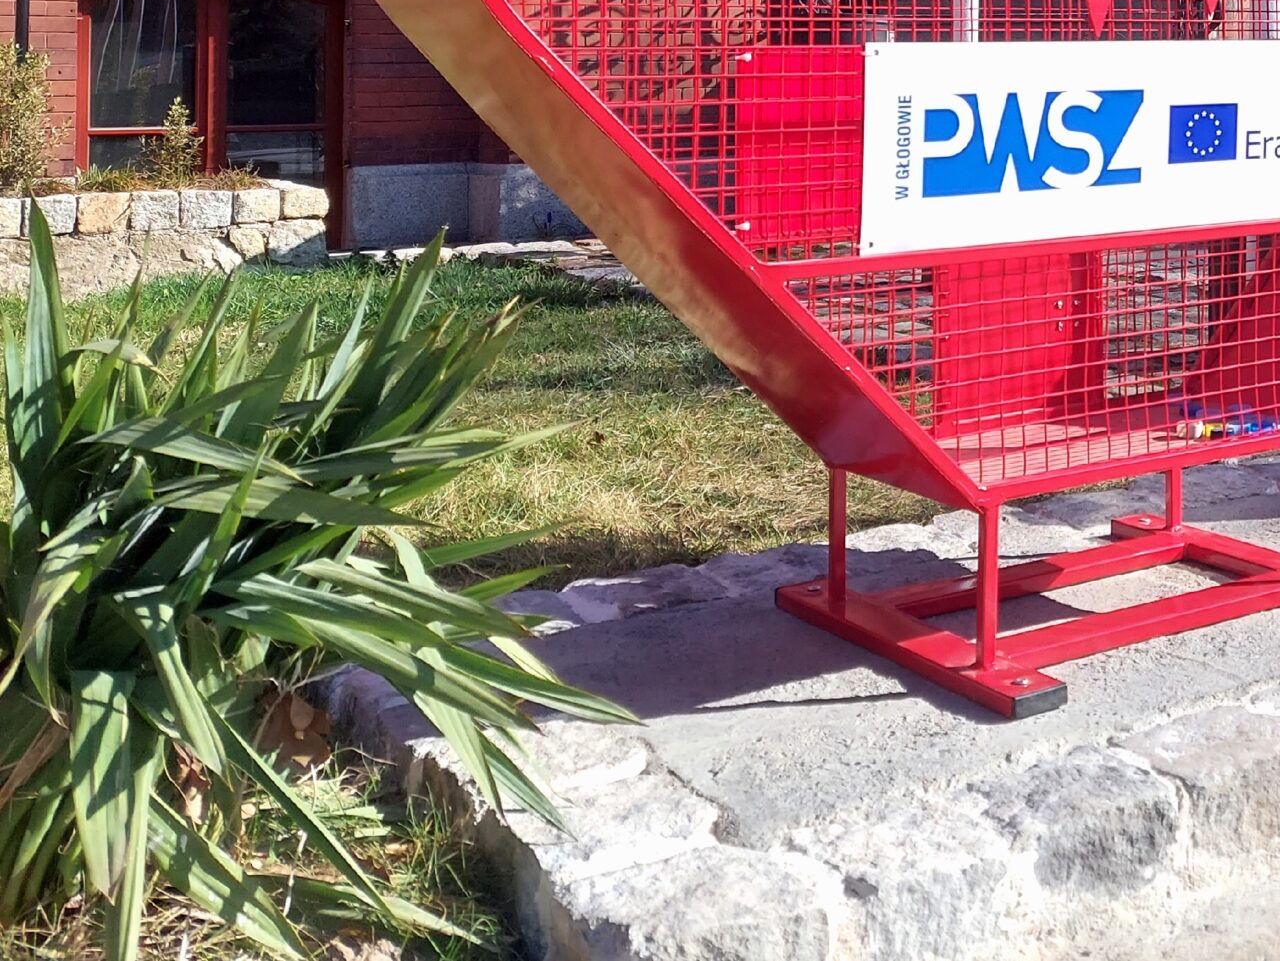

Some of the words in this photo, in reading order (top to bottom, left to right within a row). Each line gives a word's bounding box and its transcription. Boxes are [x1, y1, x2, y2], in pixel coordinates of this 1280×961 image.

[896, 94, 912, 180] GŁOGOWIE
[922, 89, 1144, 198] PWSZ
[894, 185, 909, 201] W
